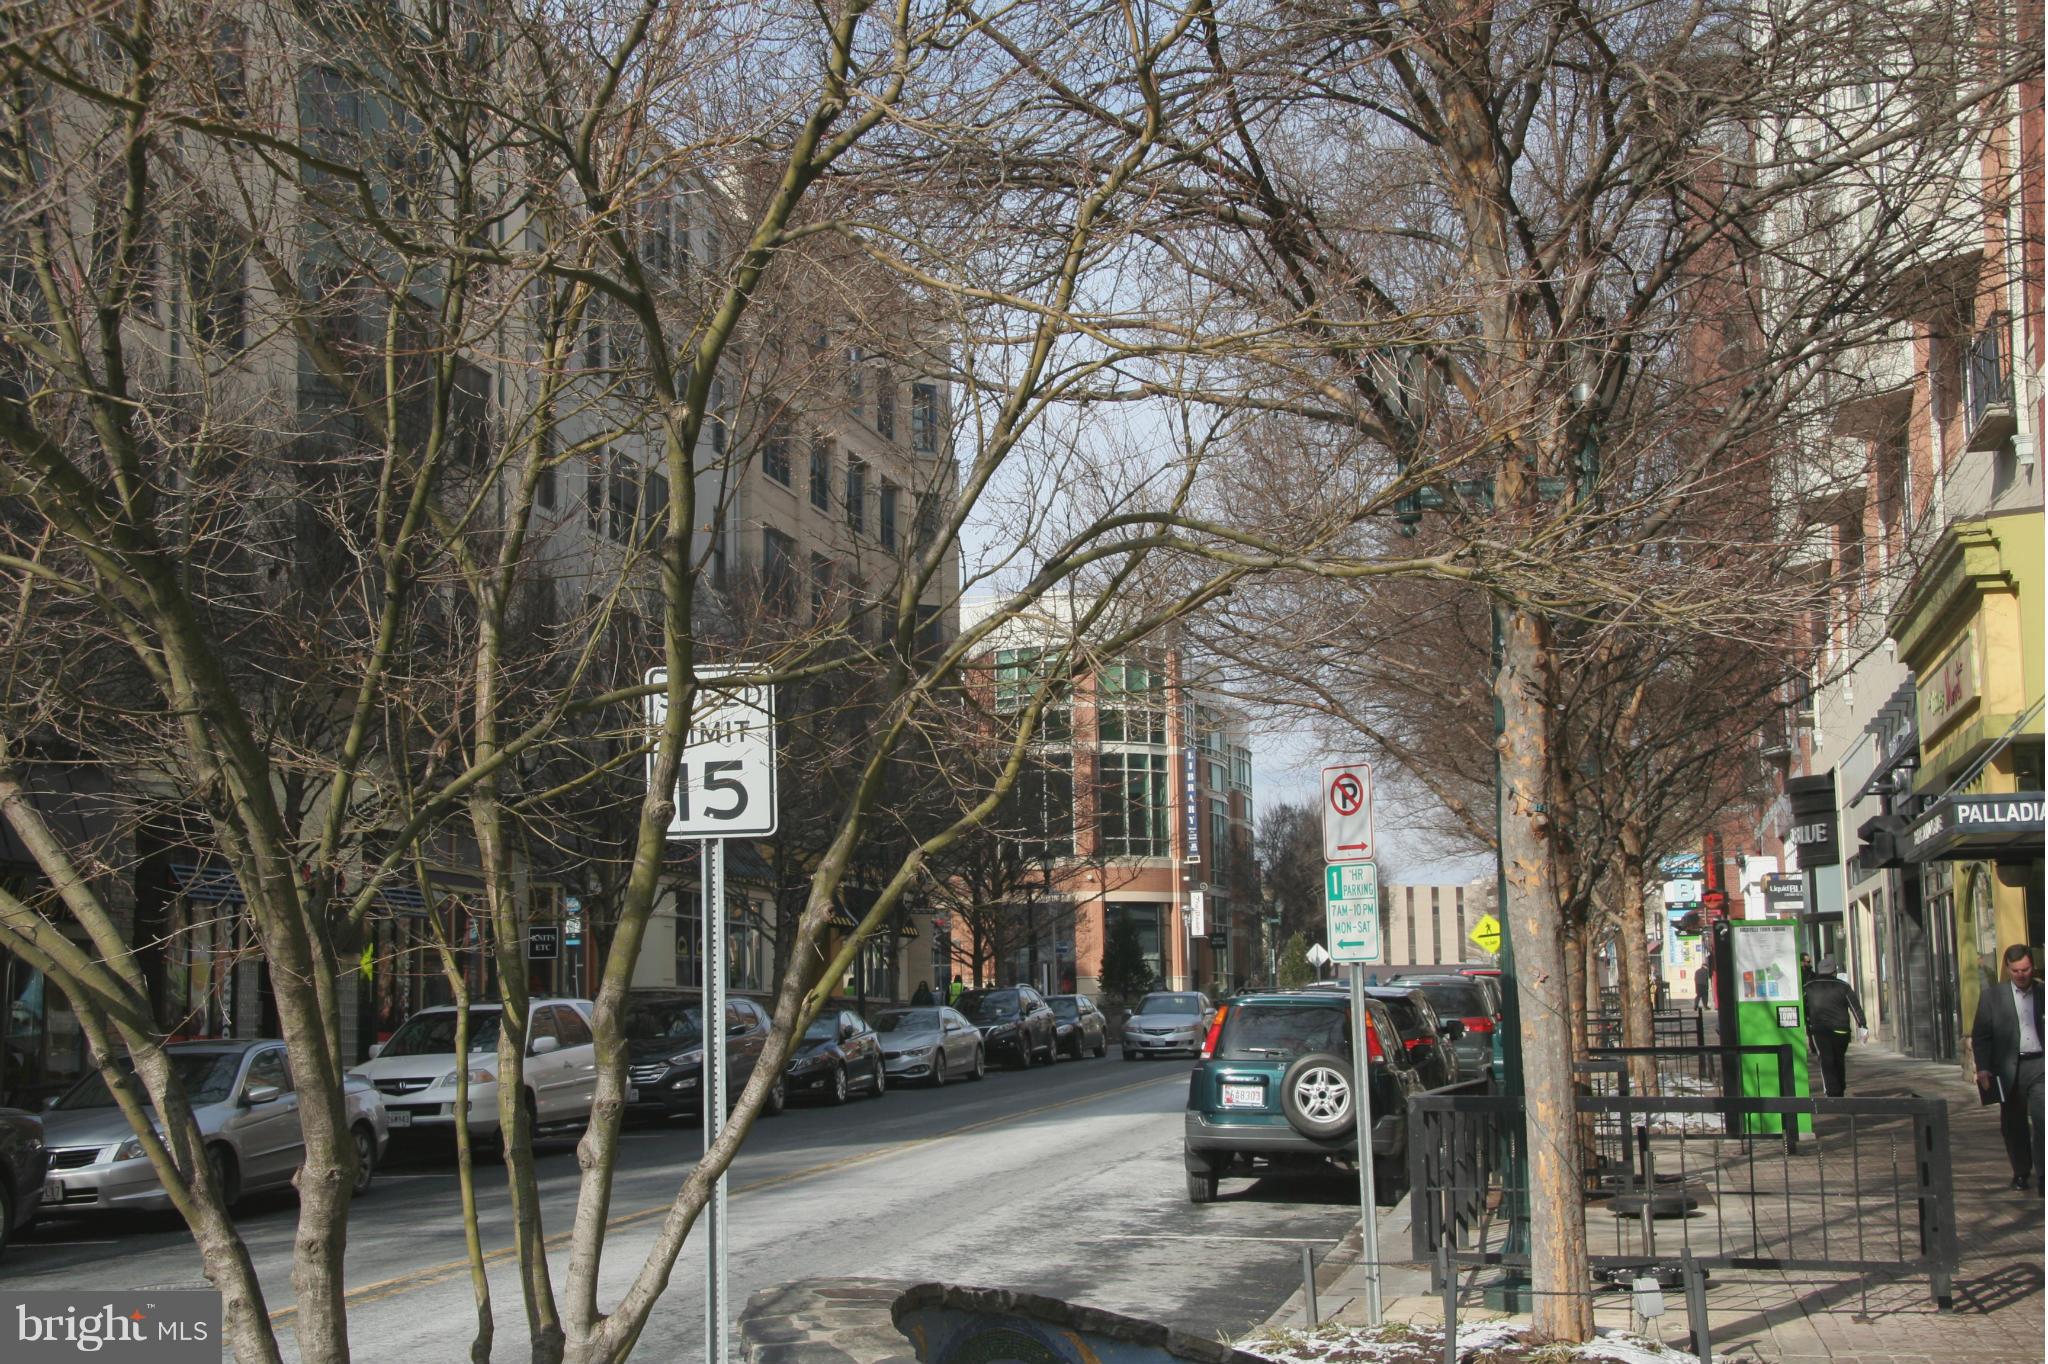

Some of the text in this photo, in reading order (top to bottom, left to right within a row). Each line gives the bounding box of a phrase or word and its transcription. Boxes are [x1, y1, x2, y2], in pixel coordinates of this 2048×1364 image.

[677, 760, 749, 821] 15
[1187, 751, 1195, 825] LIBRARY
[1332, 871, 1338, 896] 1
[1351, 868, 1364, 881] HR
[1343, 882, 1374, 897] PARKING
